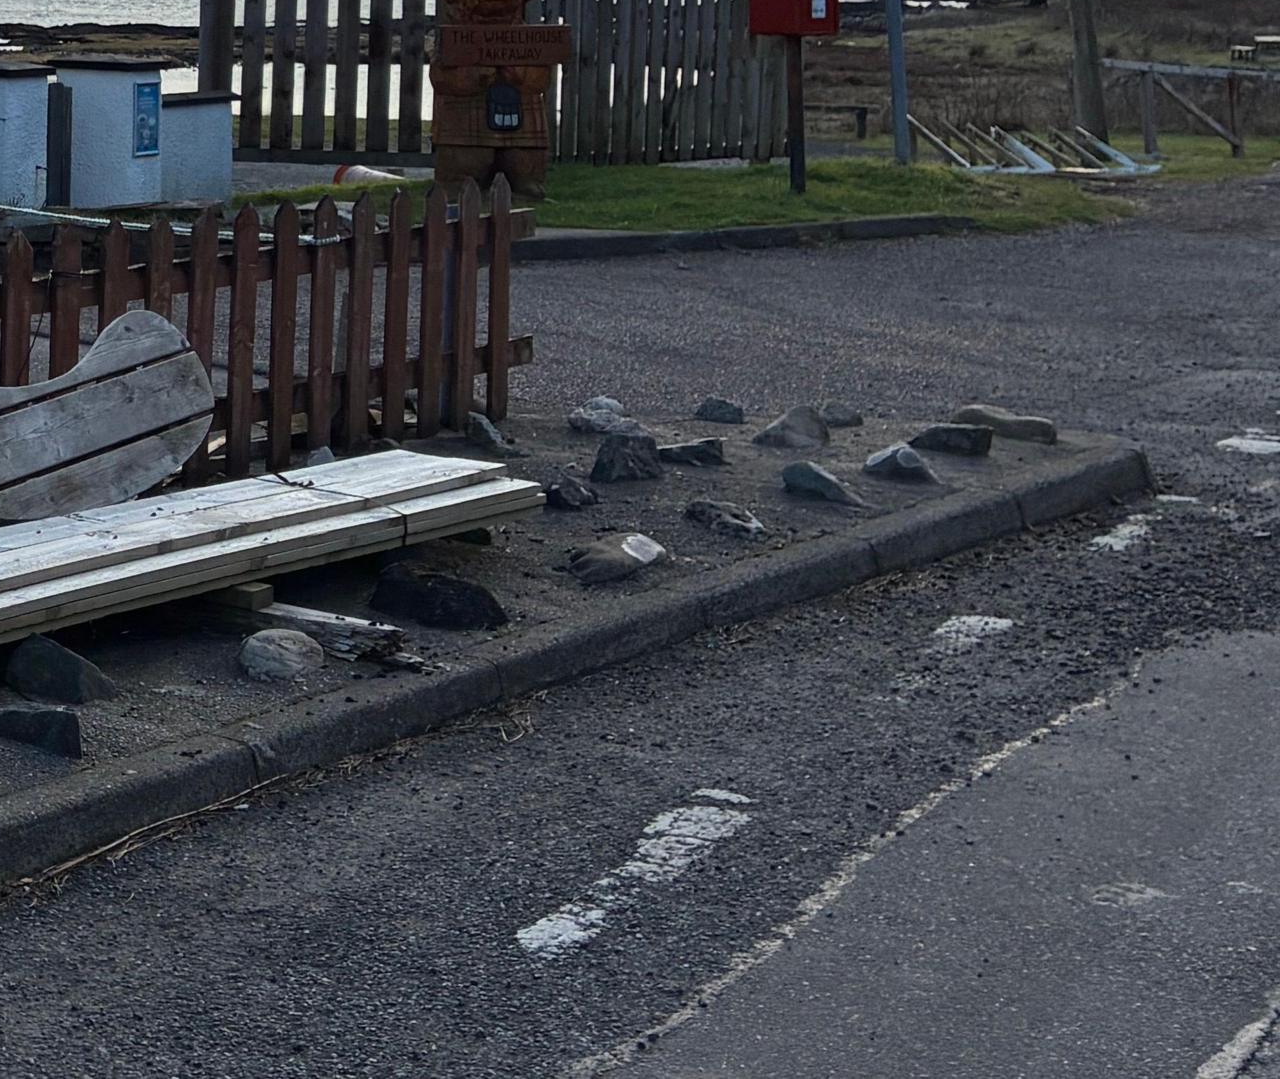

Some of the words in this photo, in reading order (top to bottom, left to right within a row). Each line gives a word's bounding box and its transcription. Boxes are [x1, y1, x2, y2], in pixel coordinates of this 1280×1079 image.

[453, 30, 476, 44] THE
[483, 30, 563, 44] WHEELHOUSE
[479, 47, 542, 61] TAKEAWAY
